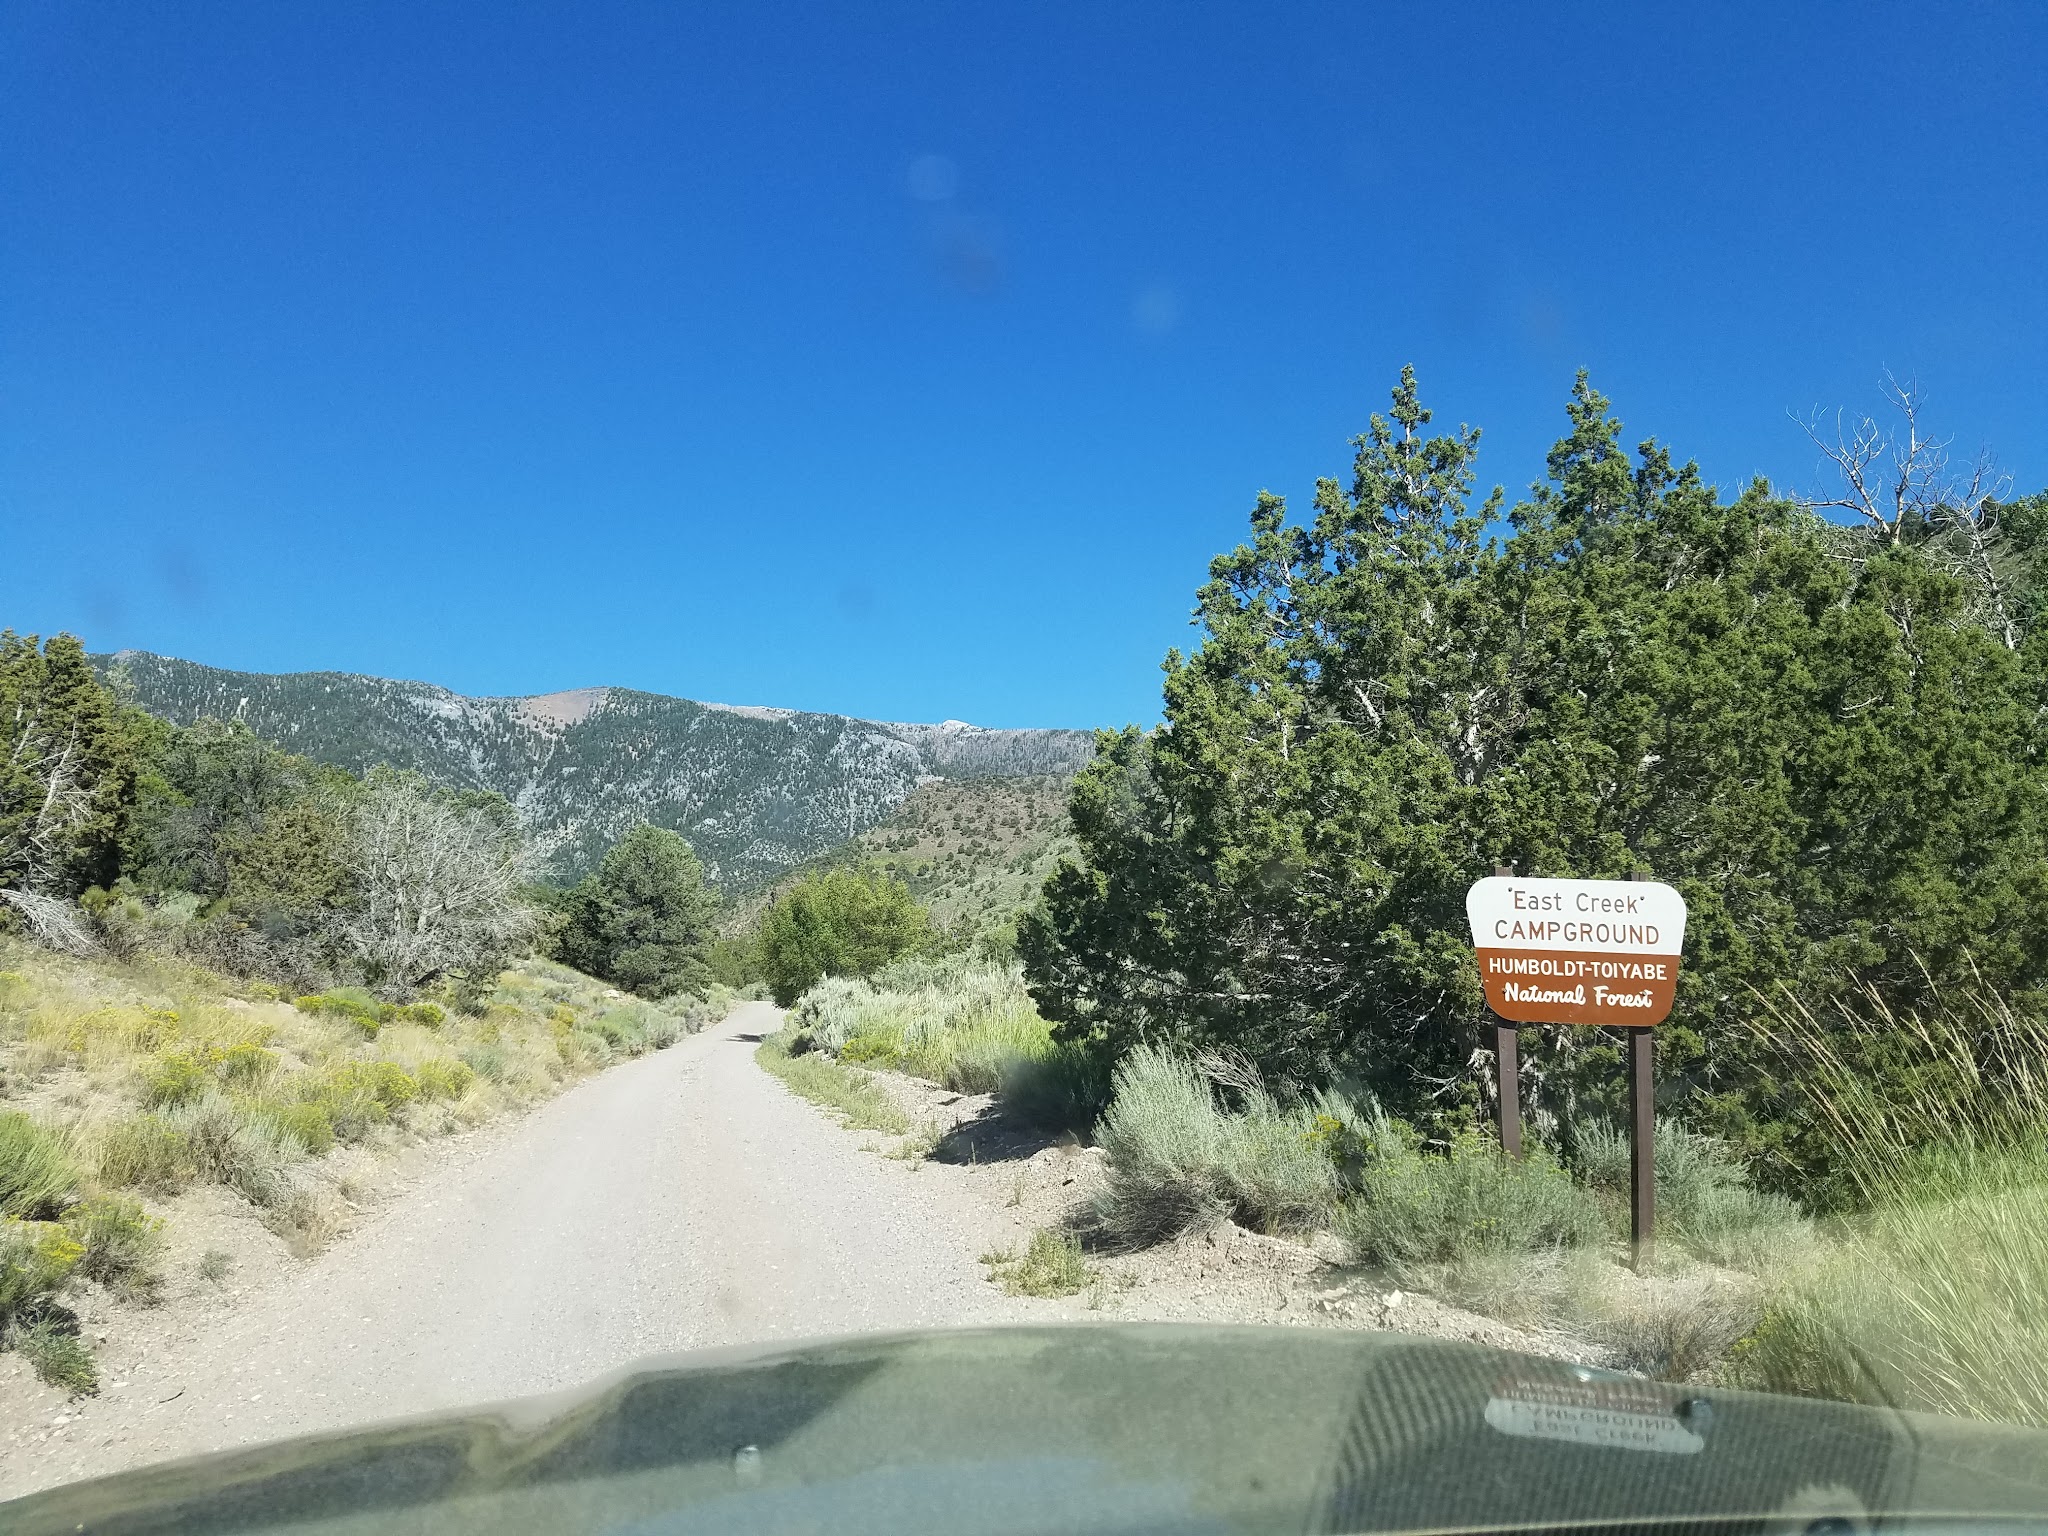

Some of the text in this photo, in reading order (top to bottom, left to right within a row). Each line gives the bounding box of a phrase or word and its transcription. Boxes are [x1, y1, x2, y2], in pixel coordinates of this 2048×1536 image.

[1514, 890, 1639, 914] East Creek
[1495, 919, 1660, 945] CAMPGROUND
[1489, 957, 1668, 981] HUMBOLDT-TOIYABE
[1504, 982, 1654, 1007] National Forest
